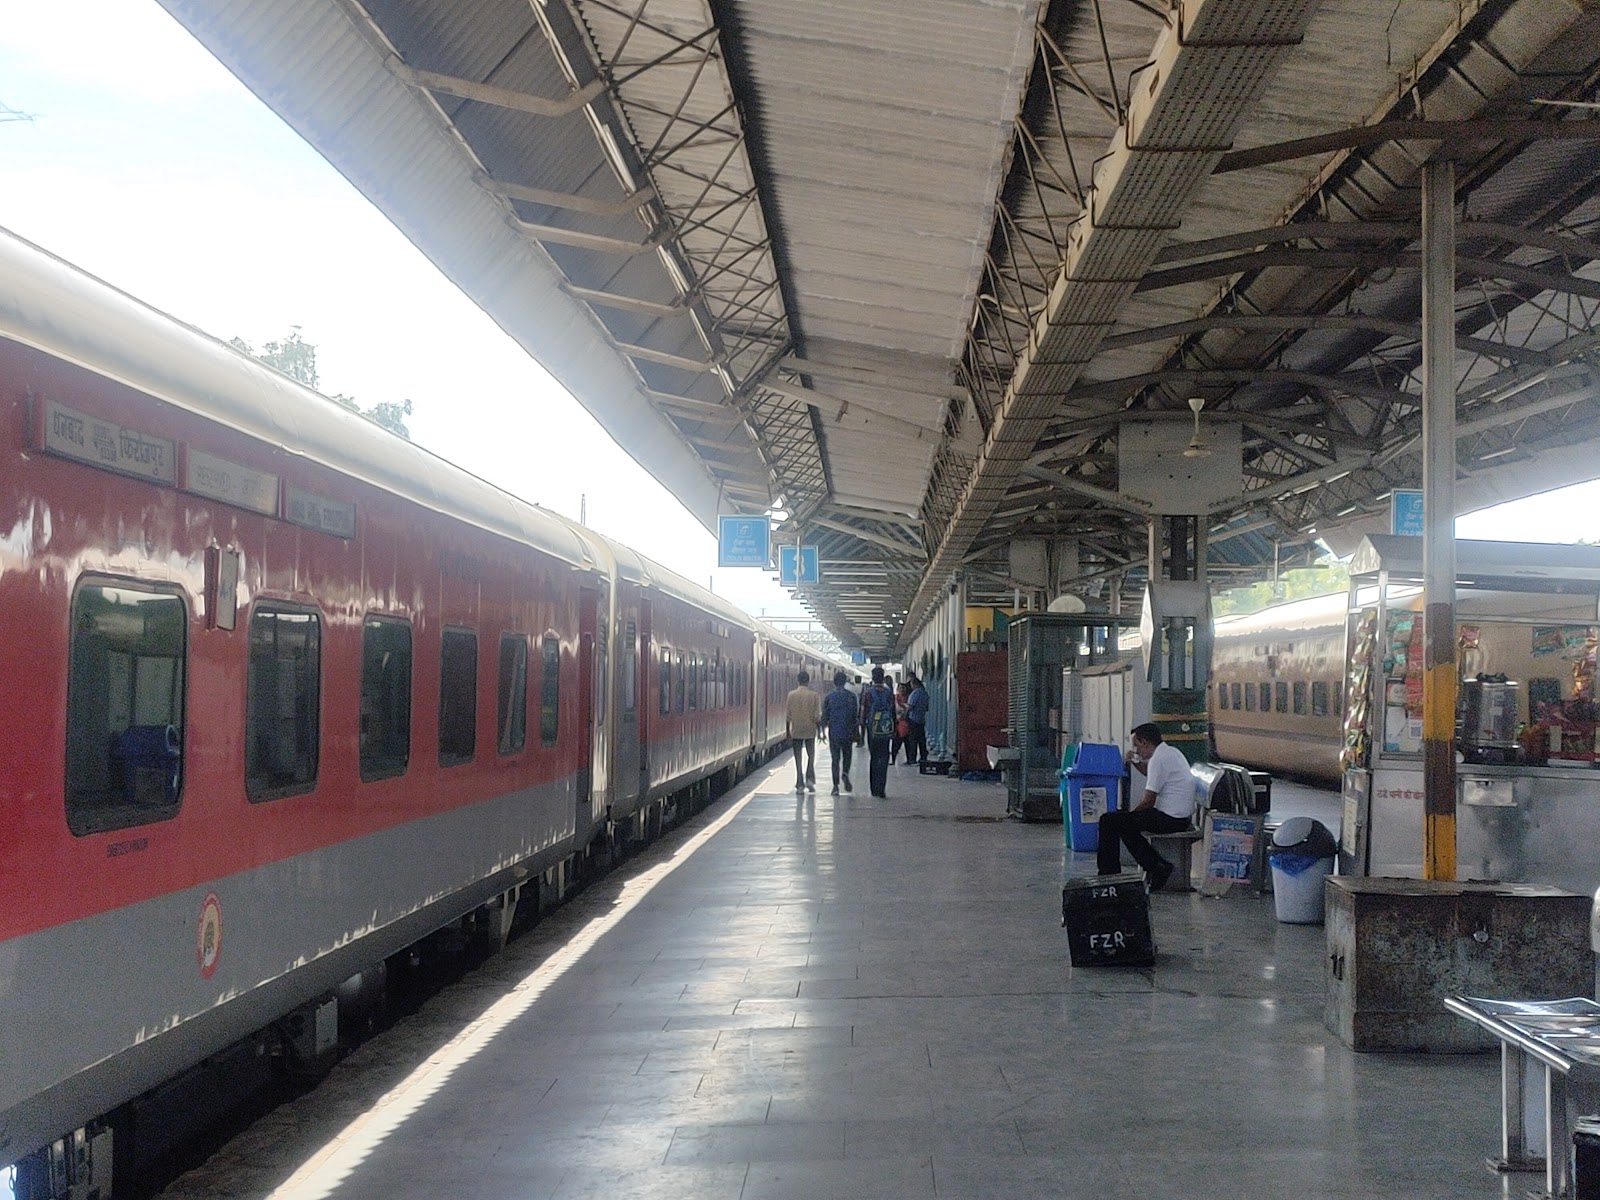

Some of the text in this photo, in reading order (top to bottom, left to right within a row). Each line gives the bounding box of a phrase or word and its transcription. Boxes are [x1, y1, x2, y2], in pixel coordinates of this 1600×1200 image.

[793, 553, 805, 577] 3
[1092, 886, 1118, 898] FZR
[1089, 930, 1126, 949] FZR
